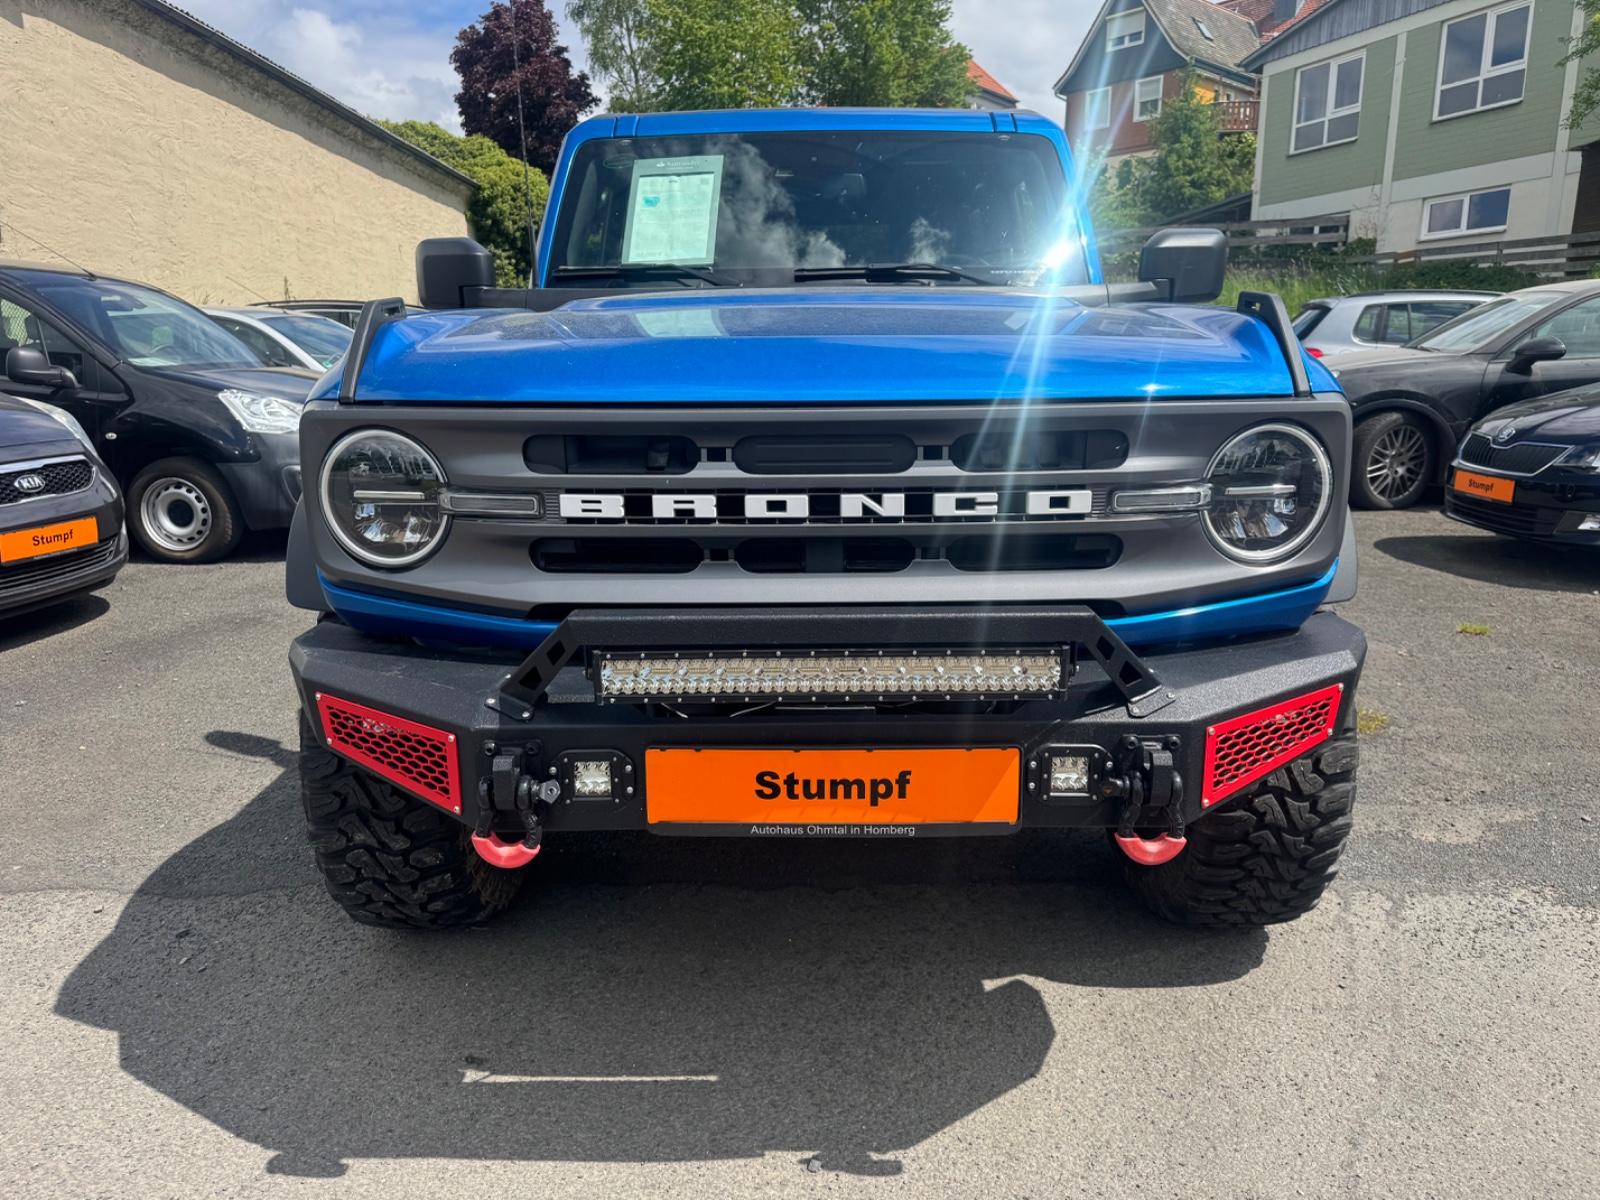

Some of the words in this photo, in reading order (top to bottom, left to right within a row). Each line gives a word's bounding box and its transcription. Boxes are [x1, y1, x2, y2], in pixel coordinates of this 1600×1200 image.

[20, 476, 42, 489] KIA
[1468, 478, 1495, 493] Stumpf
[559, 490, 1092, 518] BRONCO
[32, 529, 74, 547] Stumpf
[754, 770, 912, 807] Stumpf
[750, 825, 804, 836] Autohaus
[807, 825, 847, 836] Ohmtal
[850, 824, 860, 835] in
[864, 825, 915, 836] Homberg
